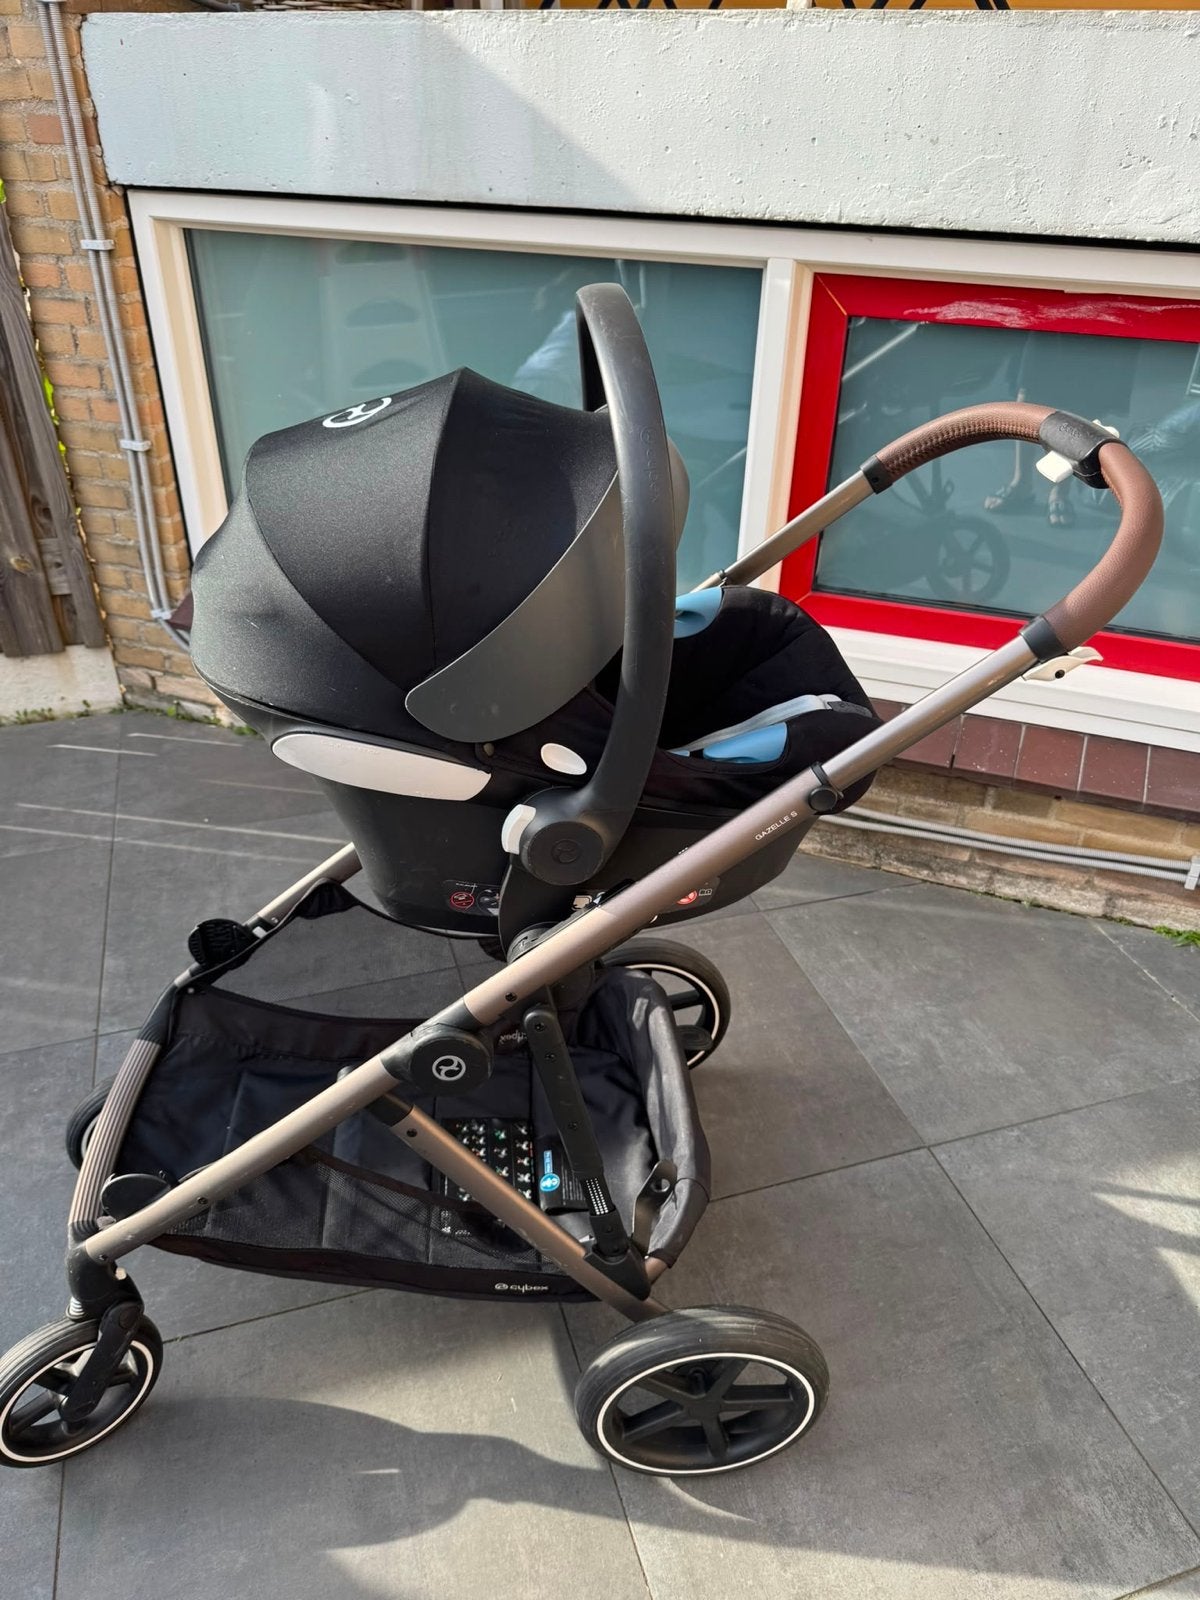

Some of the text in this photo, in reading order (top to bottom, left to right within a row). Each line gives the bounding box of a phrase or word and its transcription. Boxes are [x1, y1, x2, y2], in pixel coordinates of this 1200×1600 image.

[755, 810, 798, 840] GAZELLE S
[509, 1284, 549, 1293] cybex
